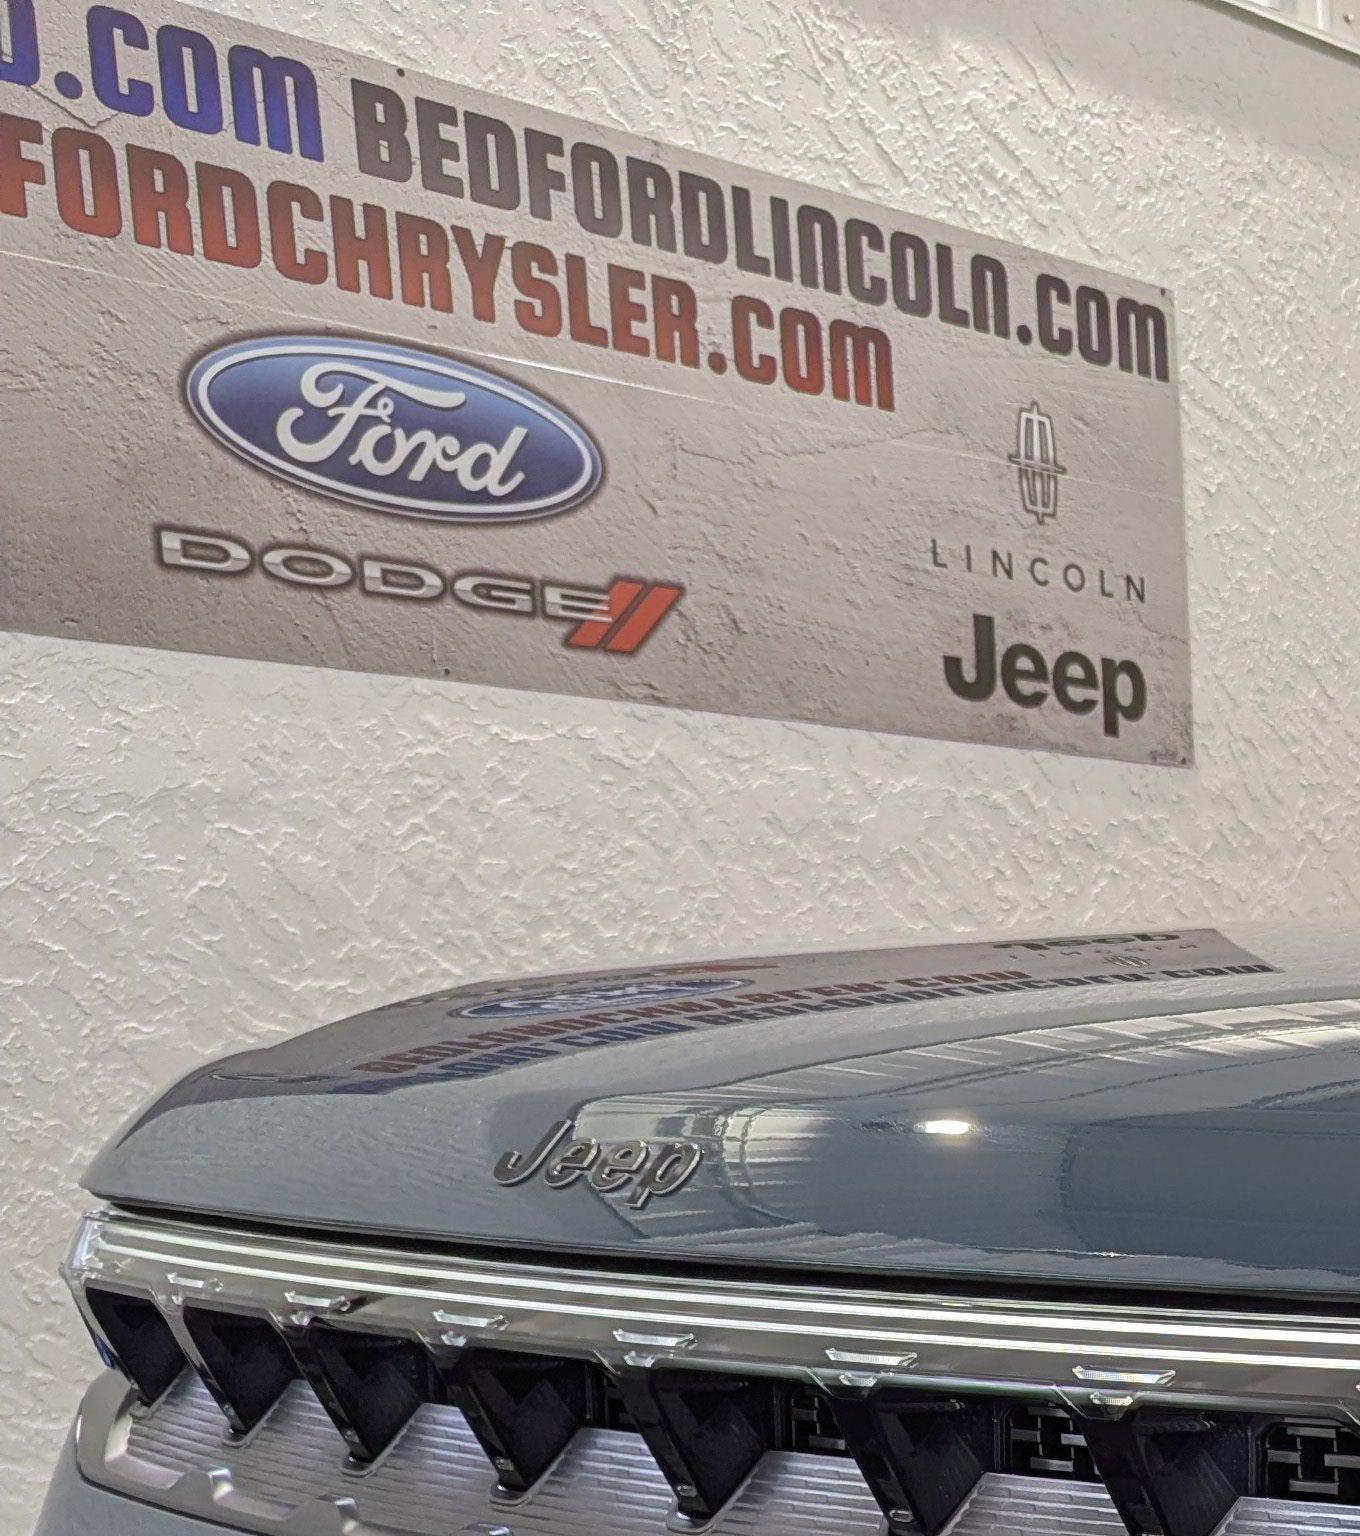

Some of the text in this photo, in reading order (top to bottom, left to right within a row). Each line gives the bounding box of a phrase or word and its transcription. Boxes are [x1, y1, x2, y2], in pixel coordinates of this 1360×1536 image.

[0, 113, 895, 413] FORDCHRYSLER.COM
[351, 78, 1170, 383] BEDFORDLINCOLN.COM
[276, 361, 529, 497] Ford
[160, 529, 614, 624] DODGE
[931, 538, 1146, 604] LINCOLN
[943, 613, 1148, 738] Jeep
[493, 1119, 704, 1210] Jeep
